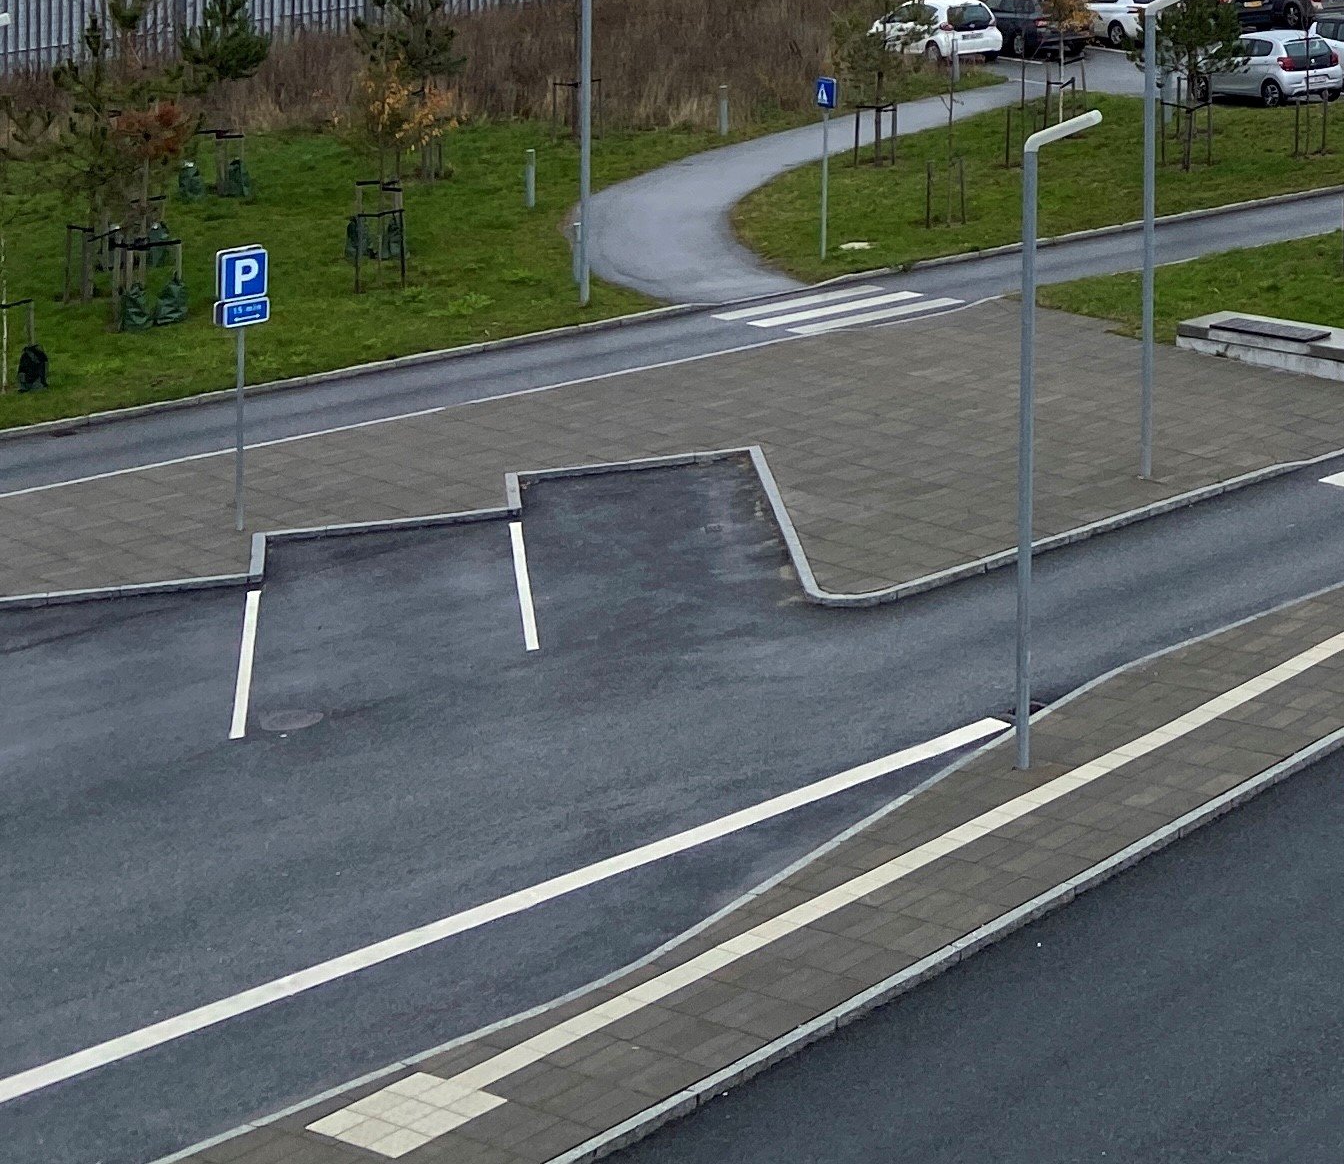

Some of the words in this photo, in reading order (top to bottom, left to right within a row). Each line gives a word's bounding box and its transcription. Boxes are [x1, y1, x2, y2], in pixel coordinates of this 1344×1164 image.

[235, 258, 258, 294] P
[233, 306, 242, 314] 15
[245, 304, 261, 312] min
